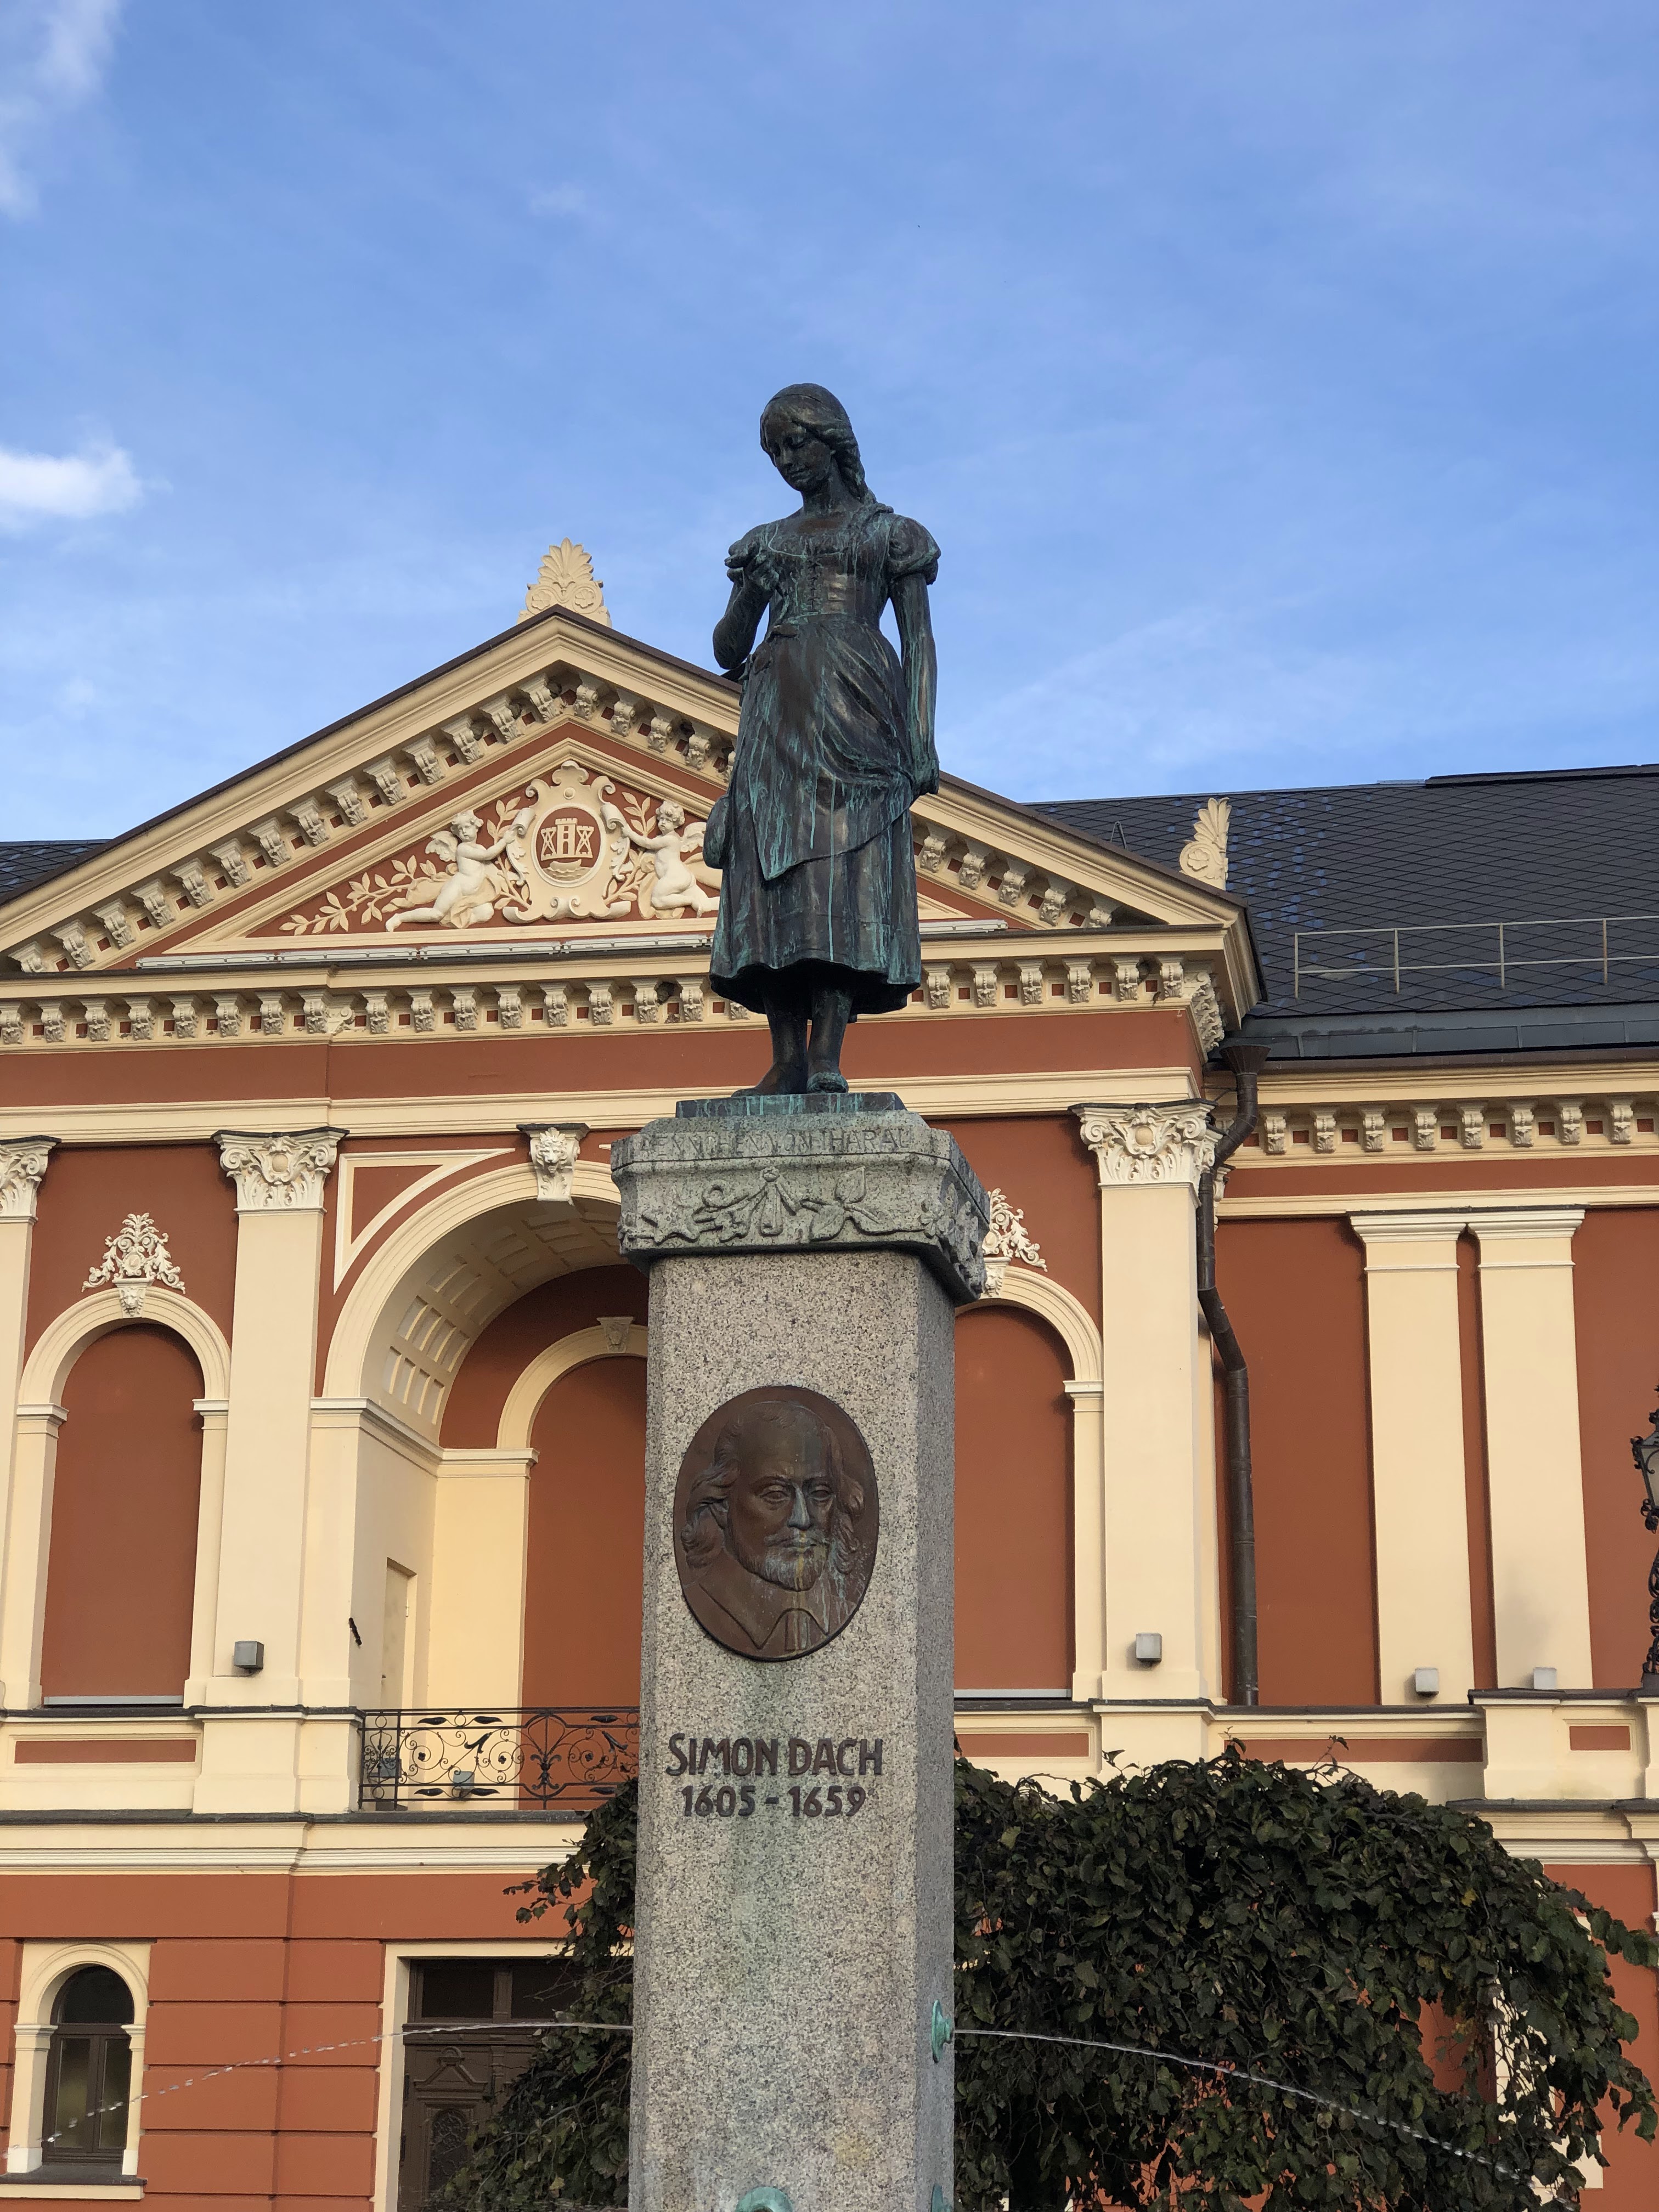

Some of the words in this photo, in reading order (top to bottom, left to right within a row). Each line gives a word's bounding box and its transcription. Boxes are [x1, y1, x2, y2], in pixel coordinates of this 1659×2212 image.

[665, 1733, 778, 1776] SIMON
[788, 1737, 883, 1776] DACH
[681, 1785, 755, 1817] 1605
[788, 1785, 866, 1817] 1659
